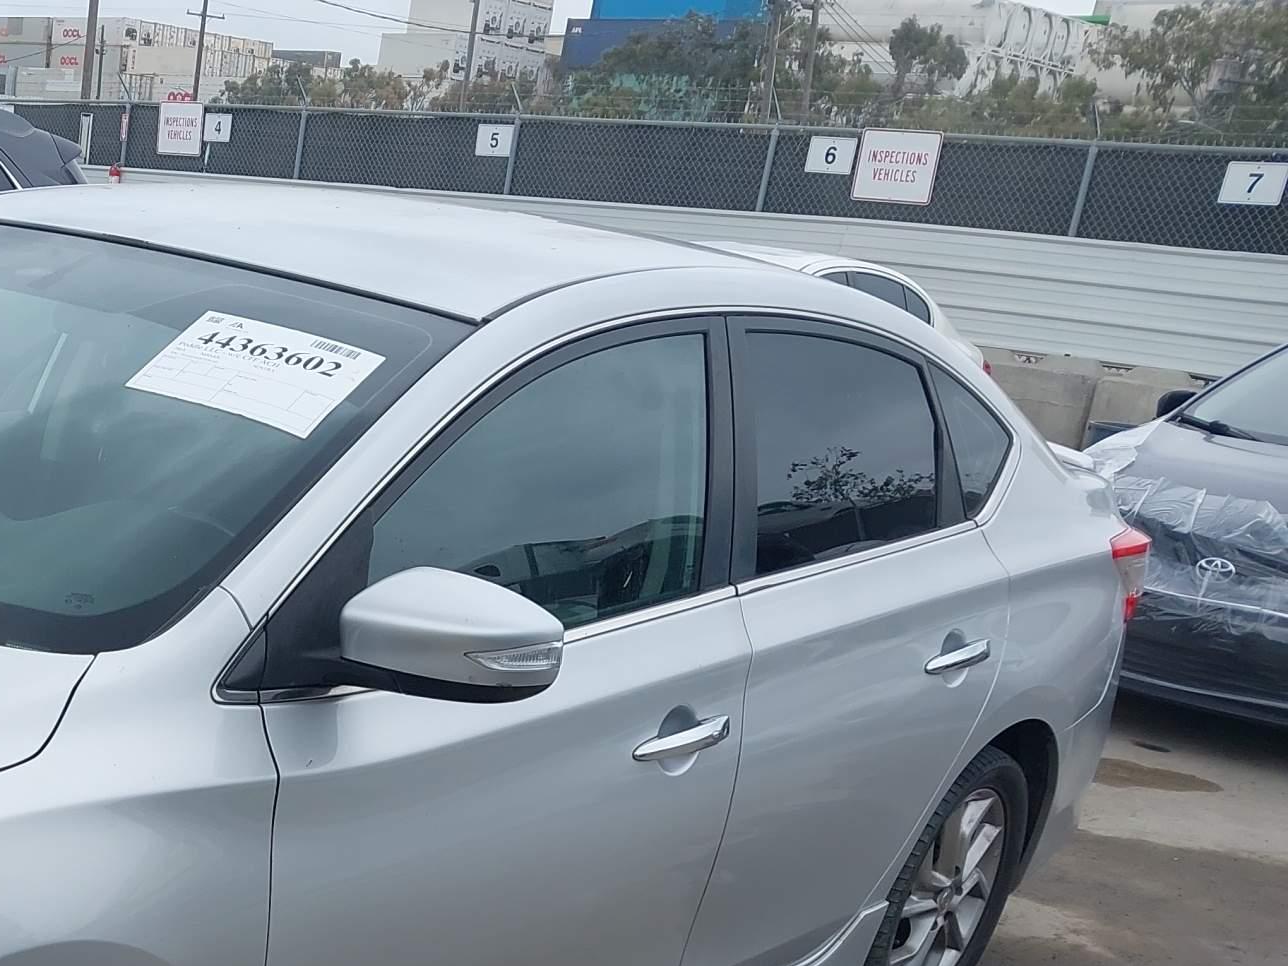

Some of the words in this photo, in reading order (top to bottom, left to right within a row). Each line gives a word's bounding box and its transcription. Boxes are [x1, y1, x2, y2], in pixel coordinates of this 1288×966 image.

[60, 56, 79, 66] OOCL
[164, 116, 198, 128] INSPECTIONS
[214, 120, 223, 135] 4
[168, 129, 192, 141] VEHICLES
[490, 132, 500, 148] 5
[824, 146, 838, 165] 6
[868, 149, 929, 166] INSPECTIONS
[872, 168, 917, 183] VEHICLES
[1247, 173, 1265, 194] 7
[197, 331, 342, 378] 44363602
